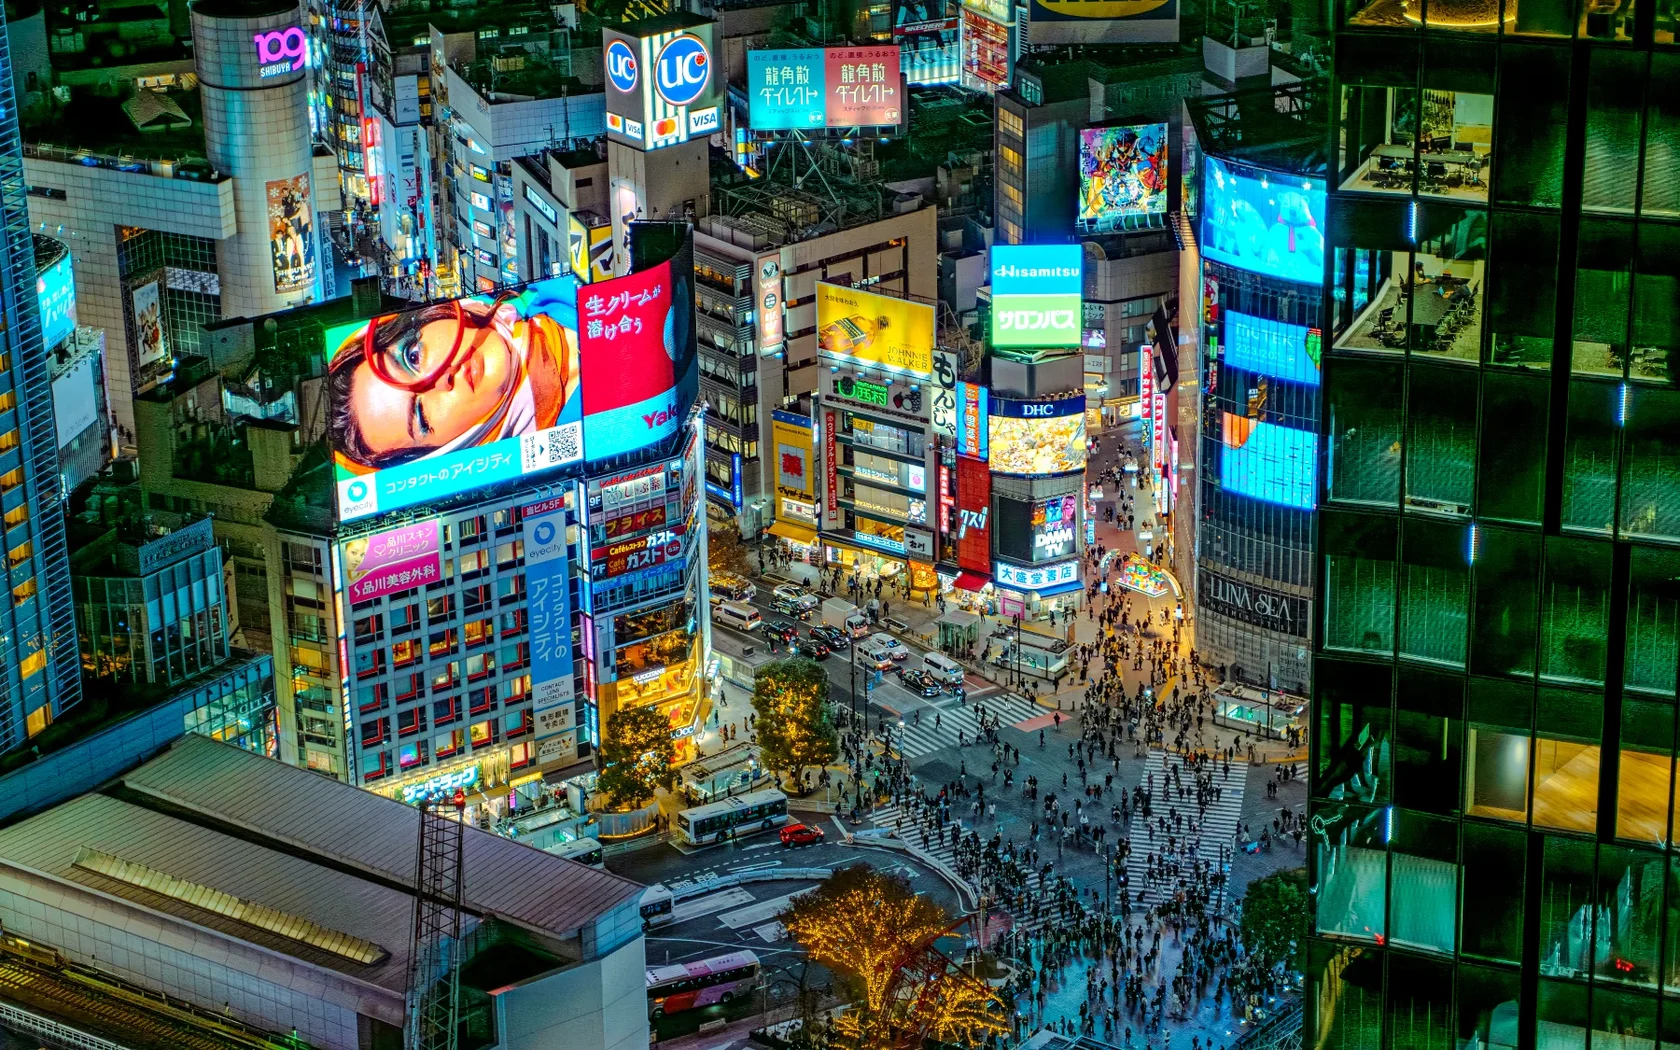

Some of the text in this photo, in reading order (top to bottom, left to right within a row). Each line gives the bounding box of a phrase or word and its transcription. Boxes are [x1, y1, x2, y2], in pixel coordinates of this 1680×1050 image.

[905, 22, 946, 32] SKECHERS
[254, 27, 305, 71] 109
[260, 62, 290, 77] SHIBUYA
[609, 51, 636, 81] UC
[661, 50, 706, 89] UC
[765, 65, 810, 85] 龍角散
[841, 63, 885, 83] 龍角散
[627, 122, 641, 135] VISA
[693, 112, 717, 127] VISA
[994, 264, 1080, 278] Hisamitsu
[585, 284, 661, 317] 生クリームが
[587, 314, 643, 340] 溶け合う
[998, 310, 1076, 330] サロンパス
[887, 346, 928, 361] JOHNNIE
[857, 387, 888, 406] 西村
[933, 352, 956, 435] もんじゃ
[1142, 378, 1150, 414] カラオケ
[1023, 404, 1054, 416] DHC
[1154, 398, 1163, 437] カラオケ
[589, 496, 602, 507] 9F
[387, 527, 433, 548] 品川スキン
[647, 530, 675, 548] ガスト
[1035, 528, 1074, 548] DMM
[388, 540, 429, 559] クリニック
[529, 543, 562, 559] eyecity
[627, 548, 661, 570] ガスト
[1045, 542, 1064, 557] TV
[362, 563, 436, 595] 品川美容外科
[592, 563, 606, 576] 7F
[1002, 566, 1073, 585] 大盛堂書店
[1211, 576, 1293, 622] LUNA SEA
[531, 577, 553, 663] アイシティ
[551, 573, 568, 659] コンタクトの
[541, 680, 565, 692] CONTACT
[537, 691, 570, 704] SPECIALISTS
